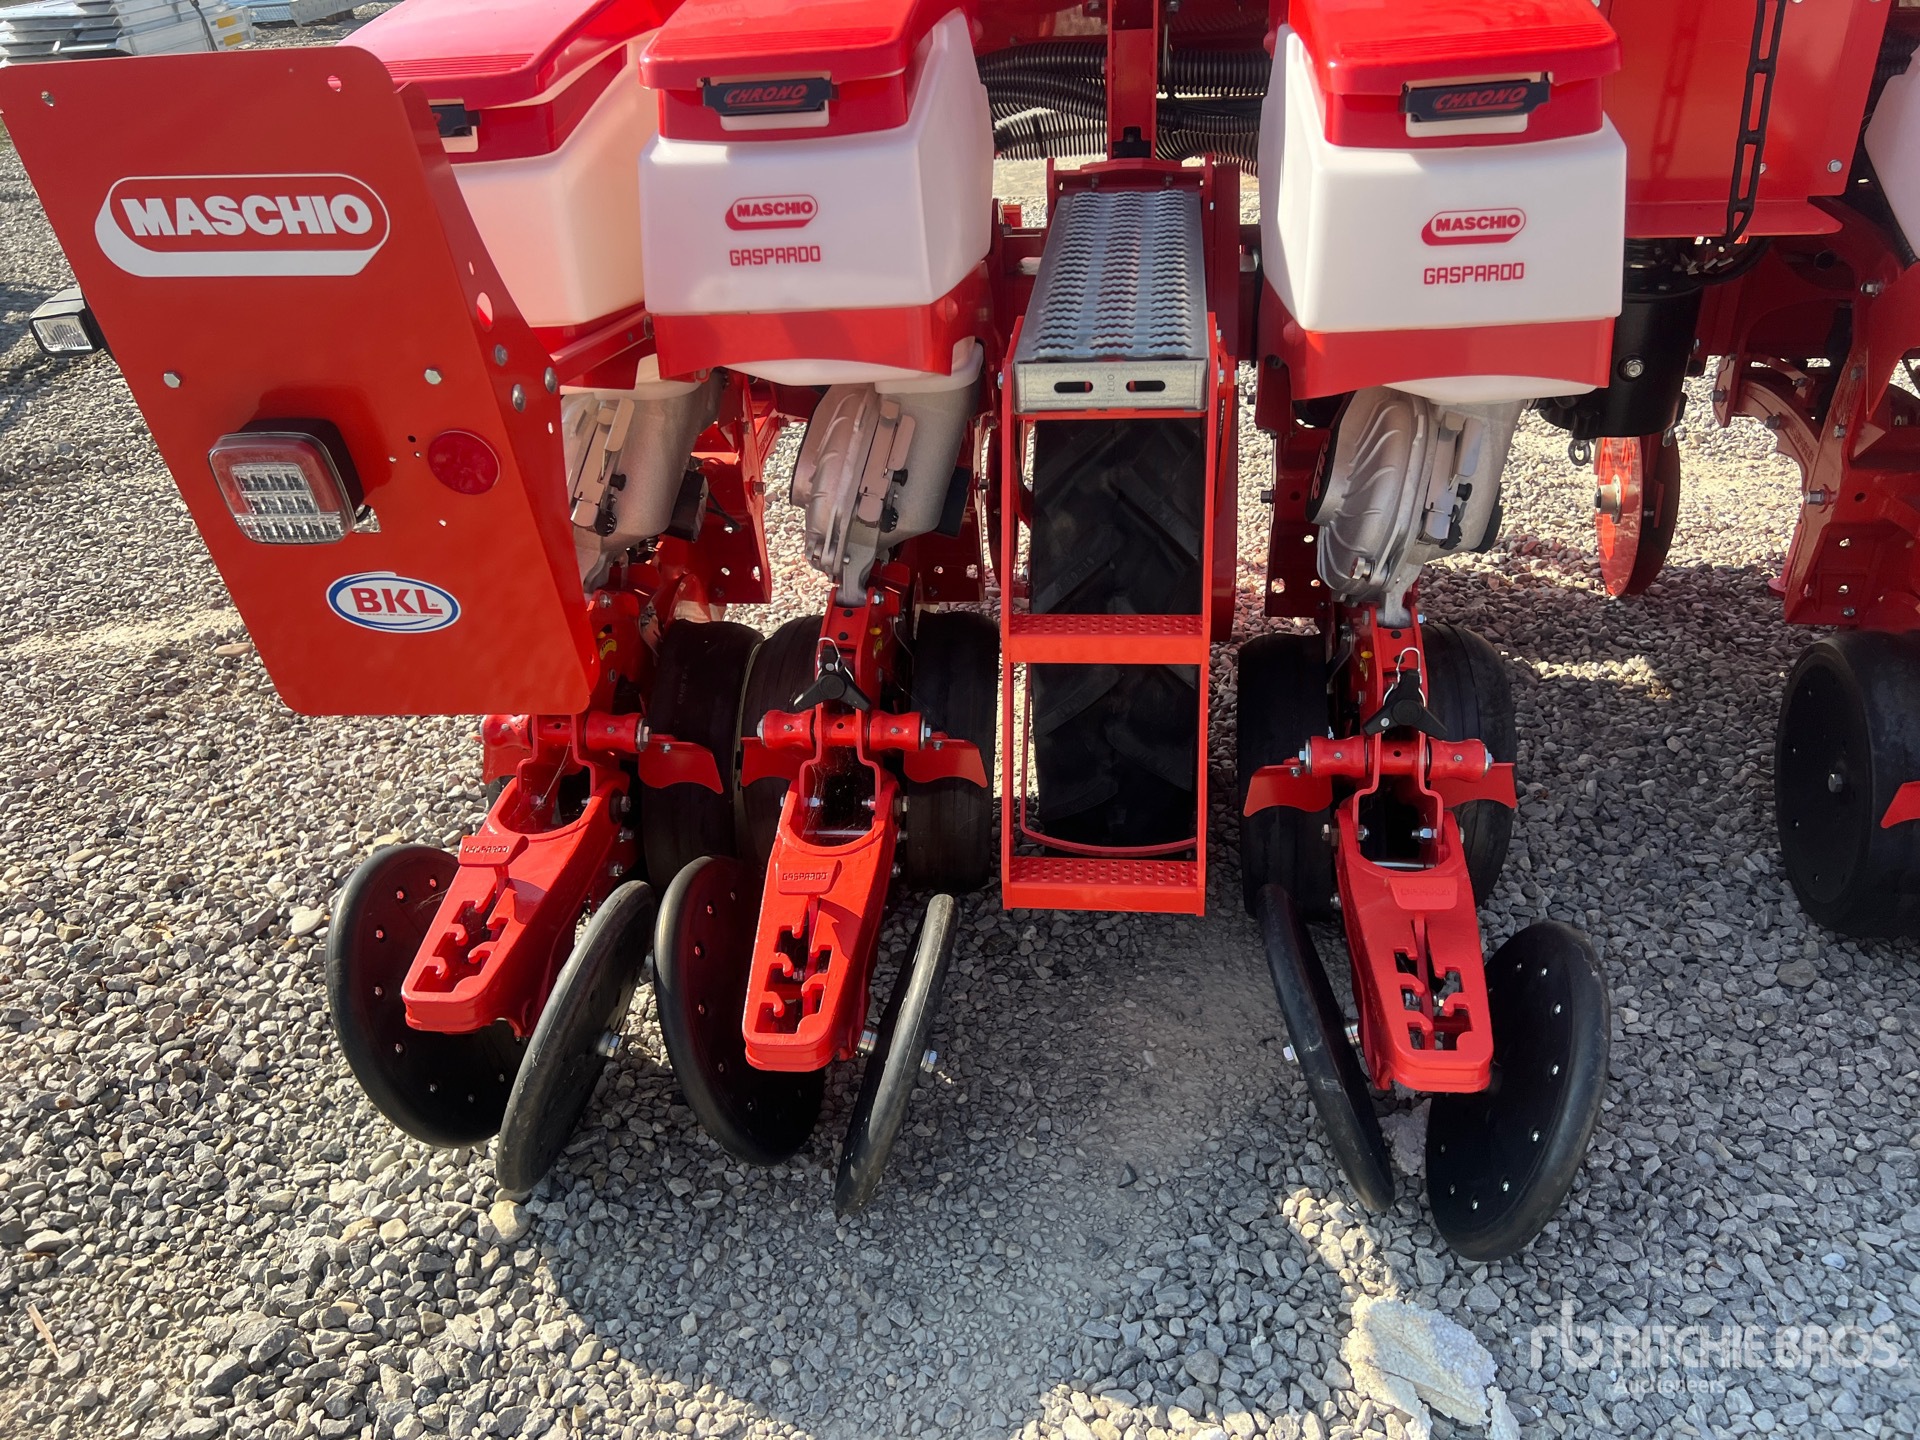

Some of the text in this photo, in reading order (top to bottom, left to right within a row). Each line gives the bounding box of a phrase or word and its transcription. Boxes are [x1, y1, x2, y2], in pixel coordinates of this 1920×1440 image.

[726, 84, 808, 104] CHRONO
[1434, 86, 1528, 110] CHRONO
[120, 194, 373, 236] MASCHIO
[736, 201, 813, 217] MASCHIO
[1435, 214, 1521, 232] MASCHIO
[729, 245, 821, 266] GASPARDO
[1423, 262, 1525, 285] GASPARDO
[350, 587, 443, 614] BKL
